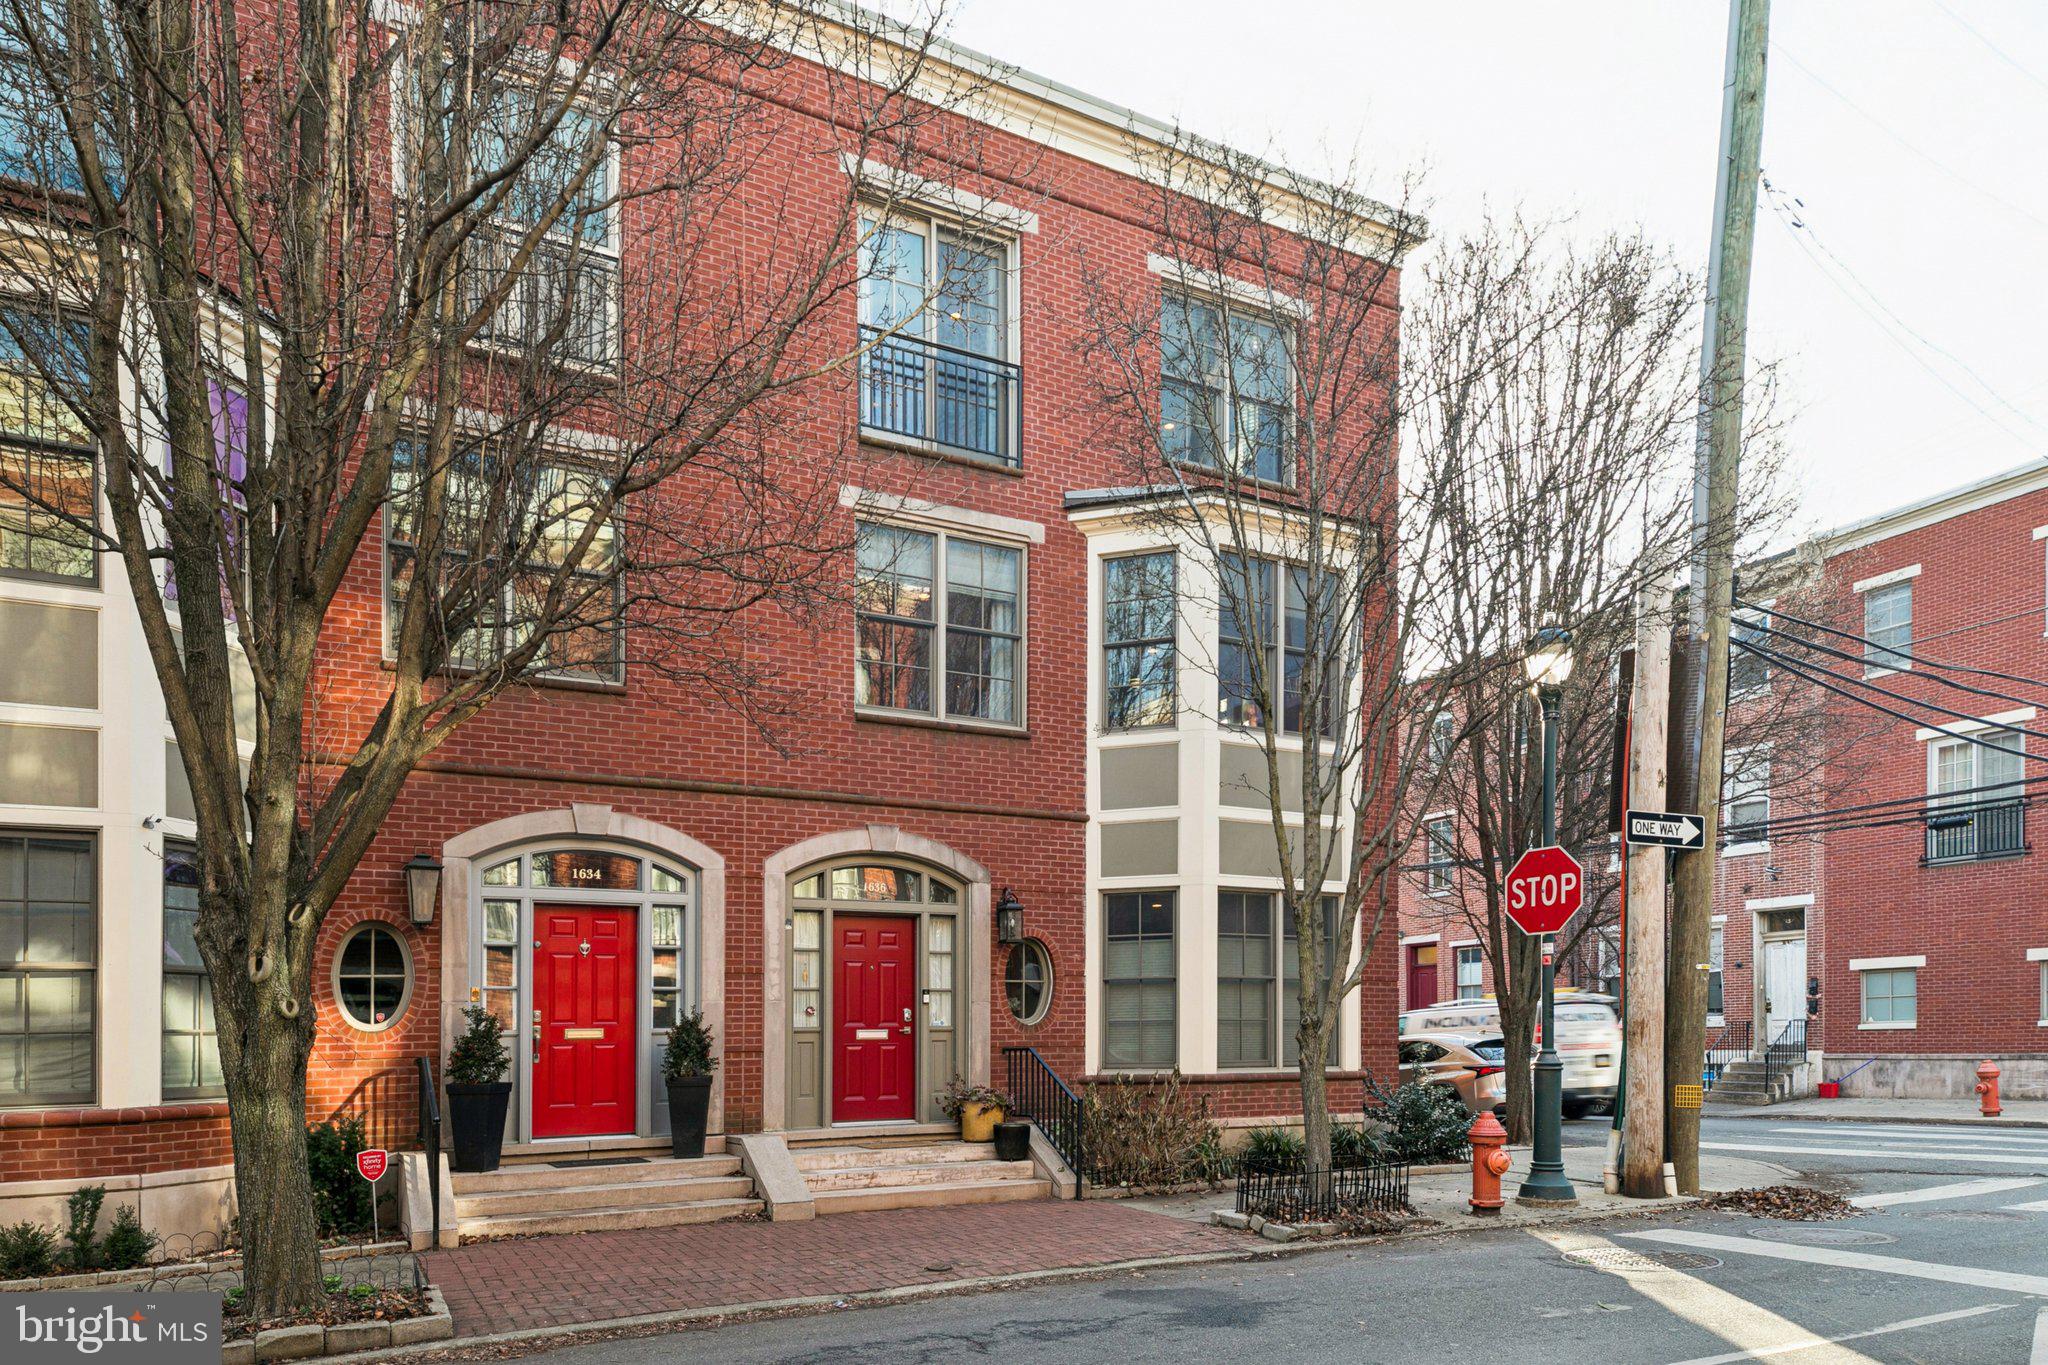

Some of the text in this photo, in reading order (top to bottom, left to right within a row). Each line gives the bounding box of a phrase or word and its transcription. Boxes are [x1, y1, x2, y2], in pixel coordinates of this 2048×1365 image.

[1634, 821, 1682, 836] ONE WAY
[572, 868, 602, 880] 1634
[864, 881, 887, 893] 1636
[1511, 872, 1577, 910] STOP
